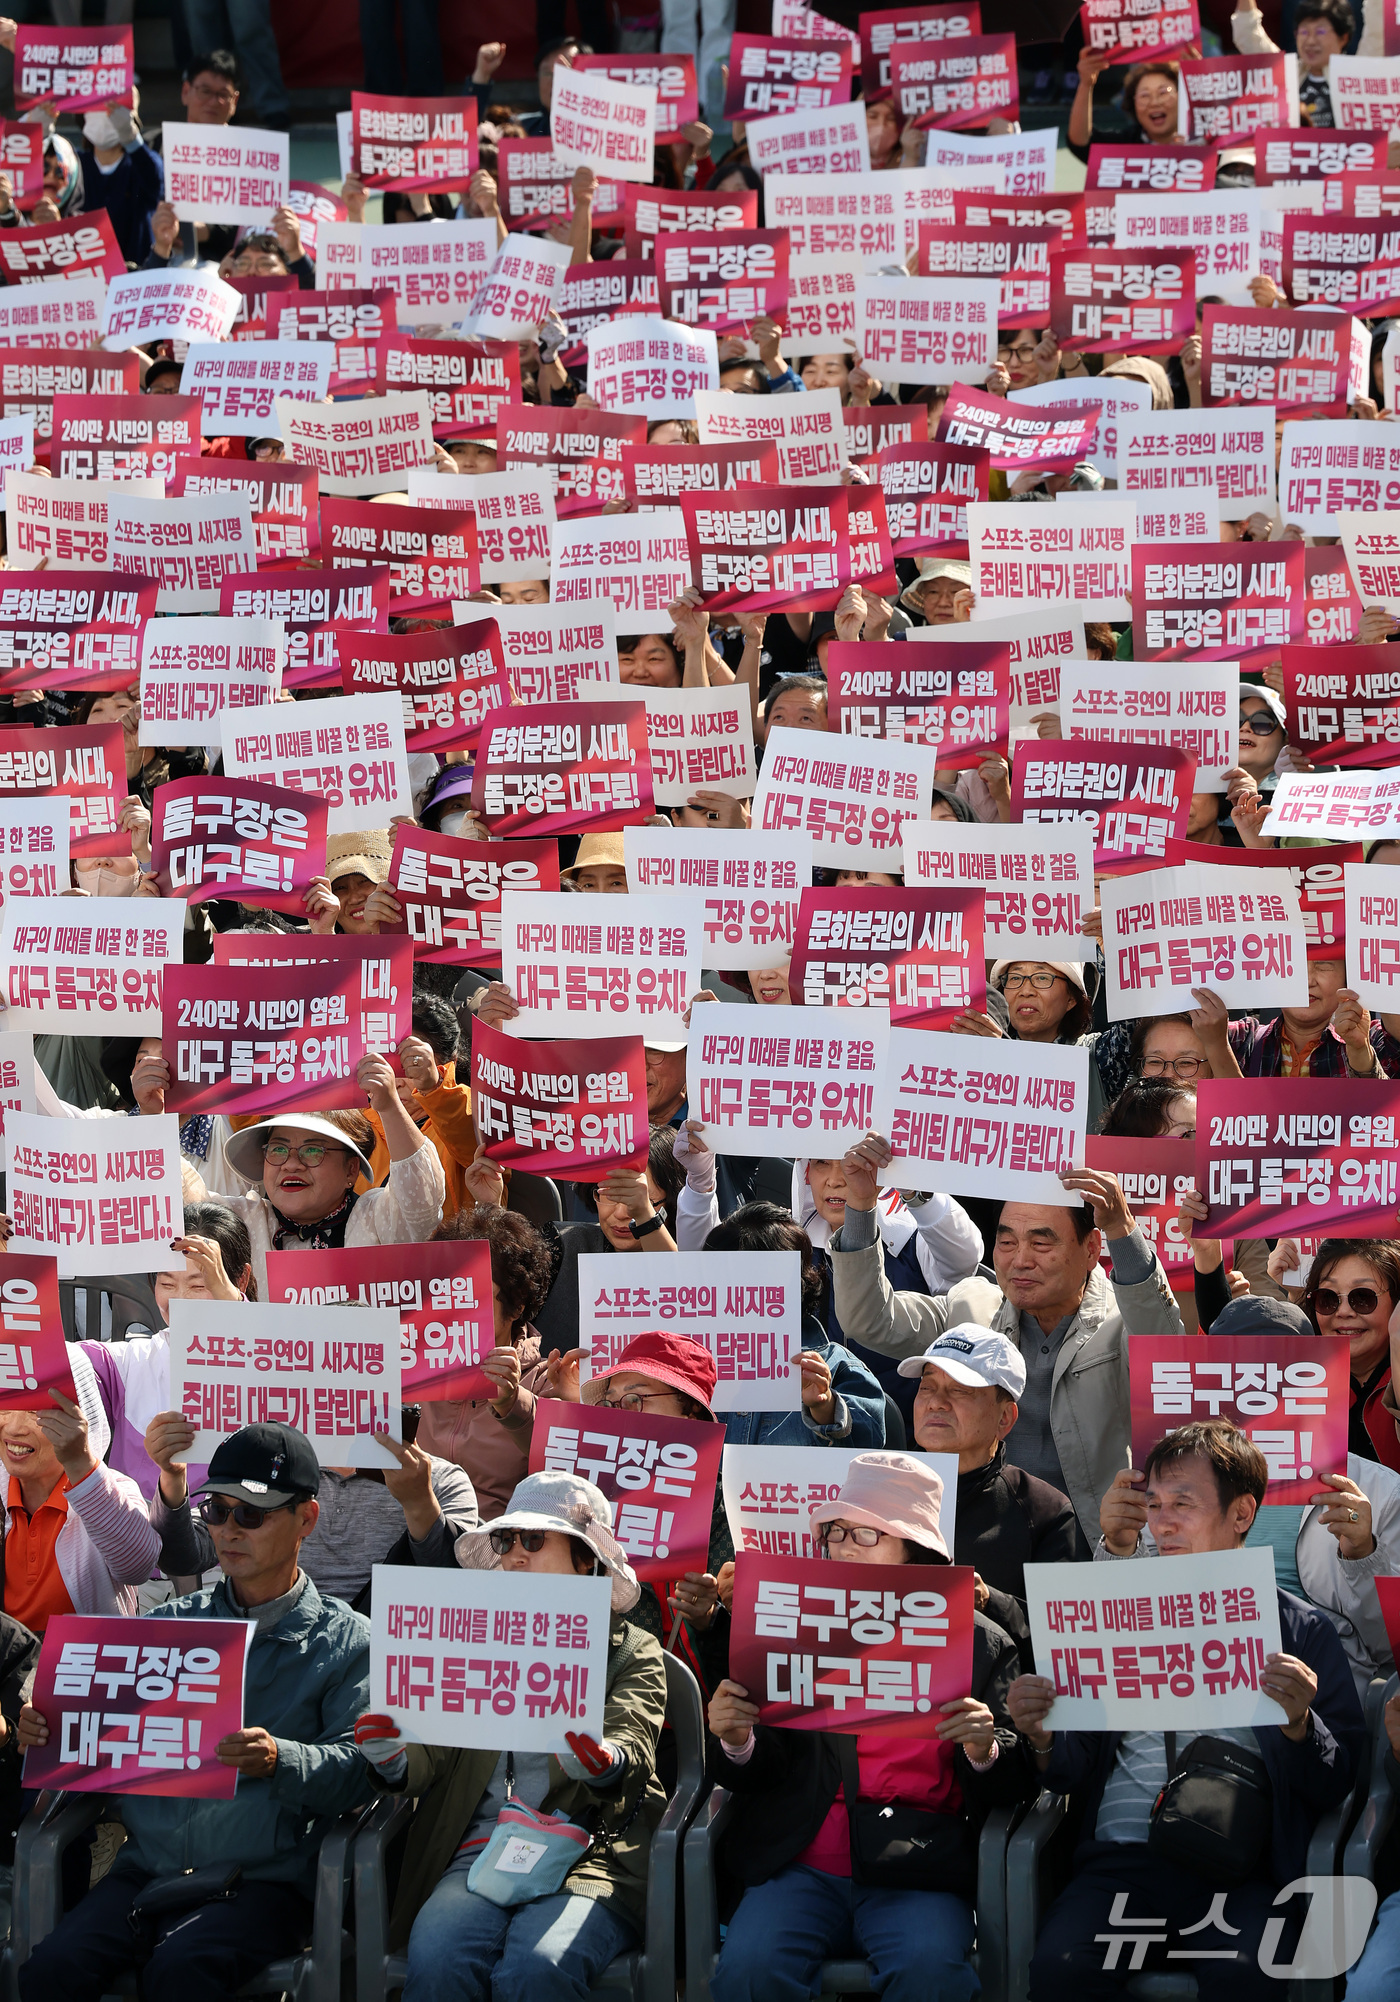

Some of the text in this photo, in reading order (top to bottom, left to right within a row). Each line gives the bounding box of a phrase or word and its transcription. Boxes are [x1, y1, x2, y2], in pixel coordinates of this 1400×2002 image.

[23, 45, 98, 65] 240만 시민의
[741, 48, 841, 82] 돔구장은
[22, 68, 126, 96] 대구 돔구장 유치!
[360, 109, 429, 141] 문화분권의
[245, 151, 279, 171] 새지평
[360, 143, 469, 178] 돔구장은 대구로!
[1265, 142, 1374, 173] 돔구장은
[172, 173, 236, 204] 준비된 대구가
[665, 244, 775, 282] 돔구장은
[929, 241, 1010, 272] 문화분권의
[1293, 231, 1376, 263] 문화분권의
[1064, 263, 1182, 299] 돔구장은
[1292, 269, 1358, 302] 돔구장은
[672, 288, 766, 322] 대구로!
[1072, 305, 1173, 340] 대구로!
[1212, 323, 1295, 359] 문화분권의
[386, 350, 466, 385] 문화분권의
[1210, 363, 1337, 402] 돔구장은 대구로!
[62, 420, 103, 443] 240만
[106, 420, 152, 444] 시민의
[379, 412, 419, 435] 새지평
[1221, 431, 1263, 453] 새지평
[332, 525, 468, 559] 240만 시민의 염원,
[695, 507, 837, 547] 문화분권의 시대,
[1079, 528, 1124, 551] 새지평
[702, 553, 839, 592] 돔구장은 대구로!
[981, 562, 1023, 597] 준비된
[1027, 564, 1070, 599] 대구가
[1145, 562, 1291, 602] 문화분권의 시대,
[1311, 573, 1350, 599] 염원,
[0, 589, 141, 629] 문화분권의 시대,
[334, 586, 377, 623] 시대,
[1146, 609, 1290, 648] 돔구장은 대구로!
[1308, 607, 1352, 644] 유치!
[74, 633, 138, 671] 대구로!
[351, 658, 457, 686] 240만 시민의
[487, 724, 636, 766] 문화분권의 시대,
[349, 761, 397, 805] 유치!
[484, 773, 640, 814] 돔구장은 대구로!
[1024, 761, 1179, 813] 문화분권의 시대,
[163, 796, 308, 854] 돔구장은
[170, 844, 294, 892] 대구로!
[397, 847, 541, 901] 돔구장은
[1117, 895, 1288, 935] 대구의 미래를 바꿀 한 걸음,
[517, 924, 687, 956] 대구의 미래를 바꿀 한 걸음,
[808, 911, 969, 959] 문화분권의 시대,
[1118, 933, 1293, 990] 대구 돔구장 유치!
[9, 966, 117, 1011] 대구 돔구장
[517, 964, 686, 1014] 대구 돔구장 유치!
[805, 963, 970, 1008] 돔구장은 대구로!
[178, 995, 349, 1030] 240만 시민의 염원,
[178, 1036, 350, 1084] 대구 돔구장 유치!
[478, 1053, 633, 1103] 240만 시민의 염원,
[701, 1078, 873, 1130] 대구 돔구장 유치!
[1023, 1077, 1075, 1112] 새지평
[478, 1091, 634, 1155] 대구 돔구장 유치!
[891, 1109, 1008, 1168] 준비된 대구가
[1210, 1115, 1399, 1148] 240만 시민의 염원,
[105, 1149, 165, 1182] 새지평
[1209, 1159, 1397, 1206] 대구 돔구장 유치!
[14, 1190, 44, 1241] 준비된
[46, 1198, 95, 1245] 대구가
[724, 1286, 784, 1317] 새지평
[321, 1342, 384, 1375] 새지평
[183, 1382, 241, 1433] 준비된
[1151, 1362, 1328, 1415] 돔구장은
[388, 1605, 590, 1649] 대구의 미래를 바꿀 한 걸음,
[754, 1581, 949, 1646] 돔구장은
[1046, 1587, 1260, 1633] 대구의 미래를 바꿀 한 걸음,
[53, 1643, 220, 1703] 돔구장은
[386, 1655, 588, 1718] 대구 돔구장 유치!
[767, 1652, 931, 1712] 대구로!
[1051, 1636, 1265, 1700] 대구 돔구장 유치!
[60, 1712, 202, 1770] 대구로!
